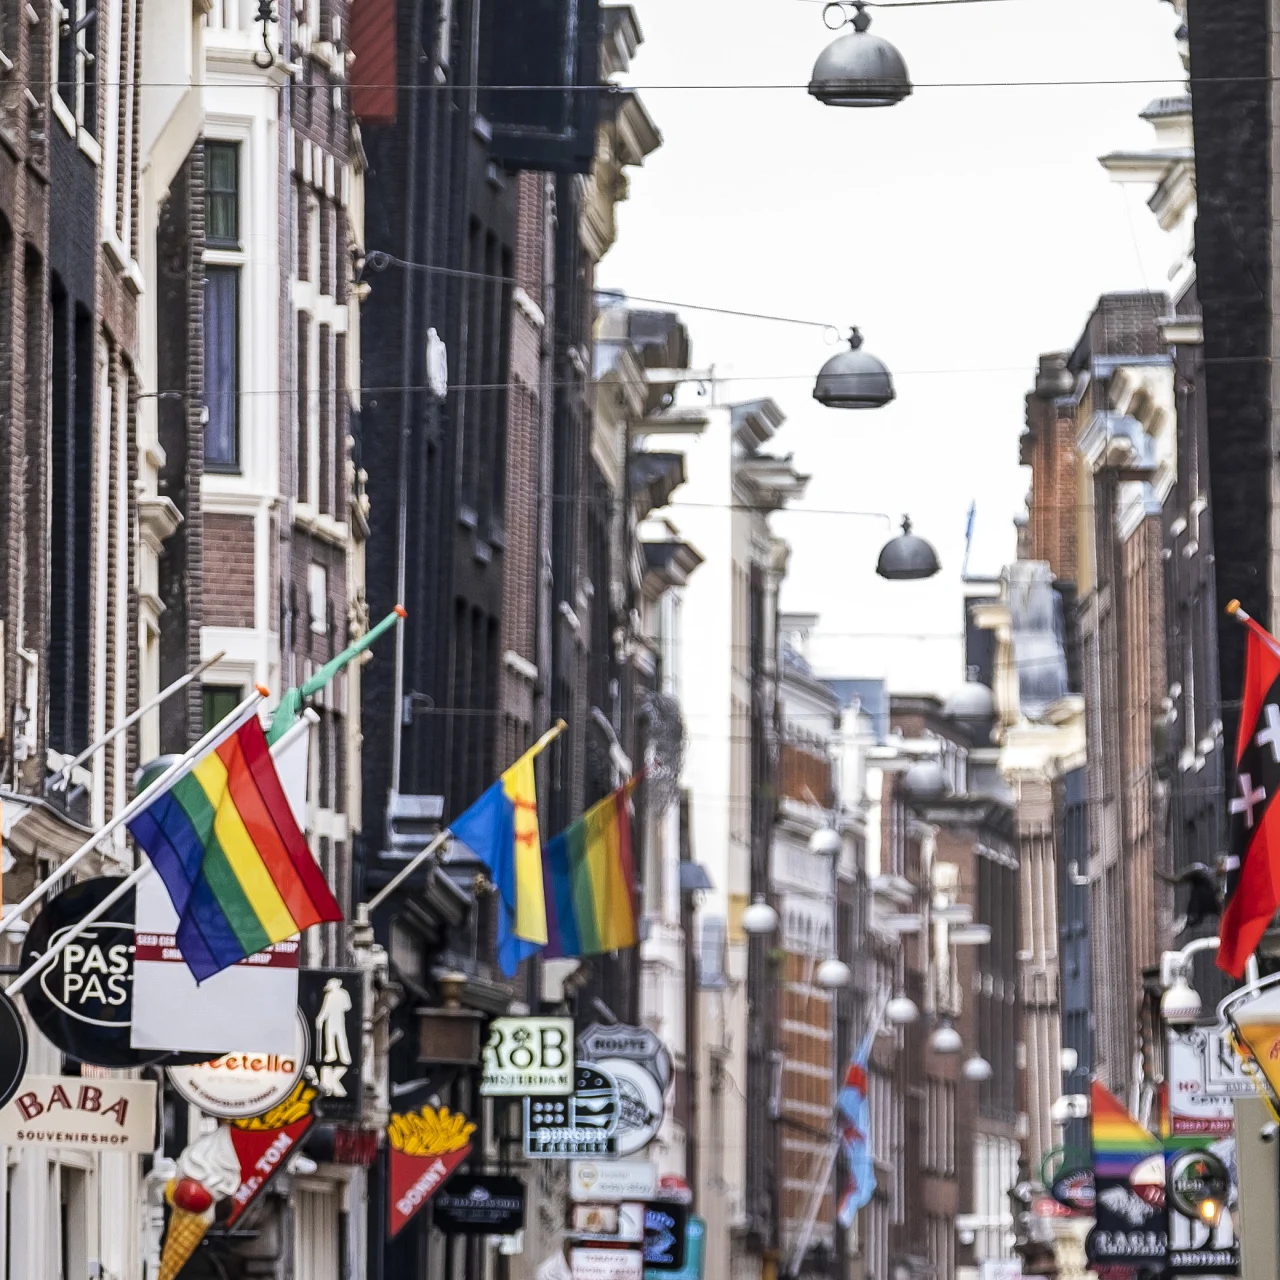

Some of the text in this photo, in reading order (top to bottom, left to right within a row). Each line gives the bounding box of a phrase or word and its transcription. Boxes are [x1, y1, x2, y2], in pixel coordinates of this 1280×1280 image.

[192, 1053, 295, 1074] eetella
[14, 1083, 130, 1128] BABA
[16, 1130, 130, 1145] SOUVENIRSHOP
[255, 1131, 294, 1173] TOM
